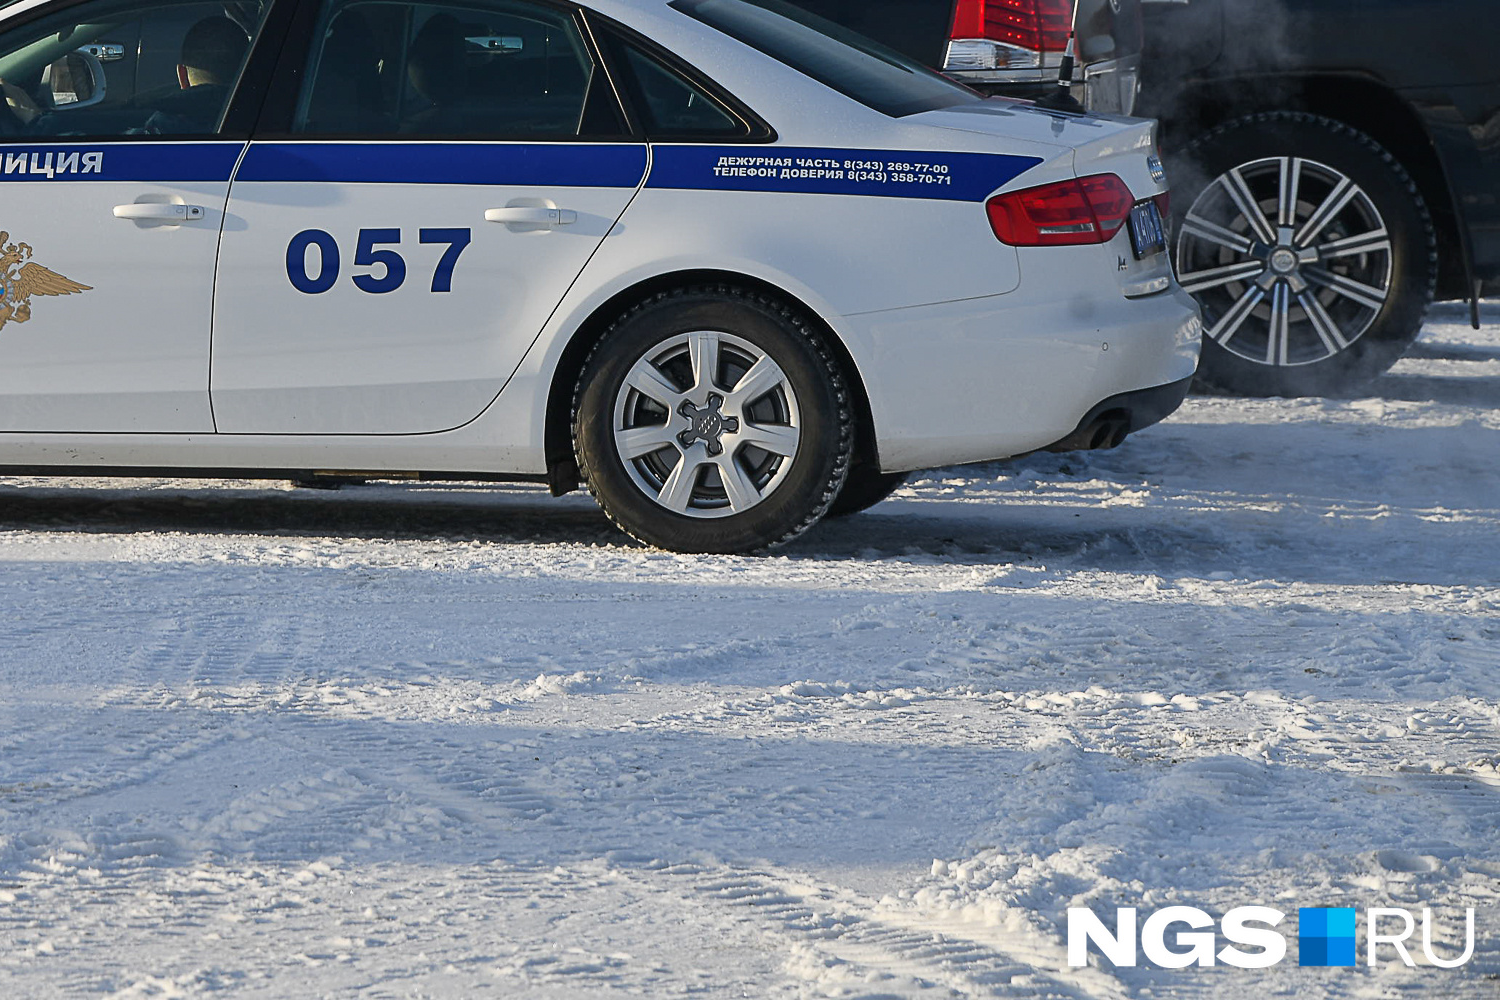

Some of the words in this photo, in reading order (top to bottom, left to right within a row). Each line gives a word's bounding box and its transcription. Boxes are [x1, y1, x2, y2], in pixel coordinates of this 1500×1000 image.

[717, 156, 792, 167] ДЕЖУРНАЯ
[796, 158, 840, 168] ЧАСТЬ
[843, 160, 883, 172] 8(343)
[887, 162, 949, 174] 269-77-00
[713, 166, 777, 177] ТЕЛЕФОН
[780, 168, 844, 180] ДОВЕРИЯ
[847, 170, 887, 183] 8(343)
[891, 172, 952, 185] 358-70-71
[286, 228, 471, 294] 057
